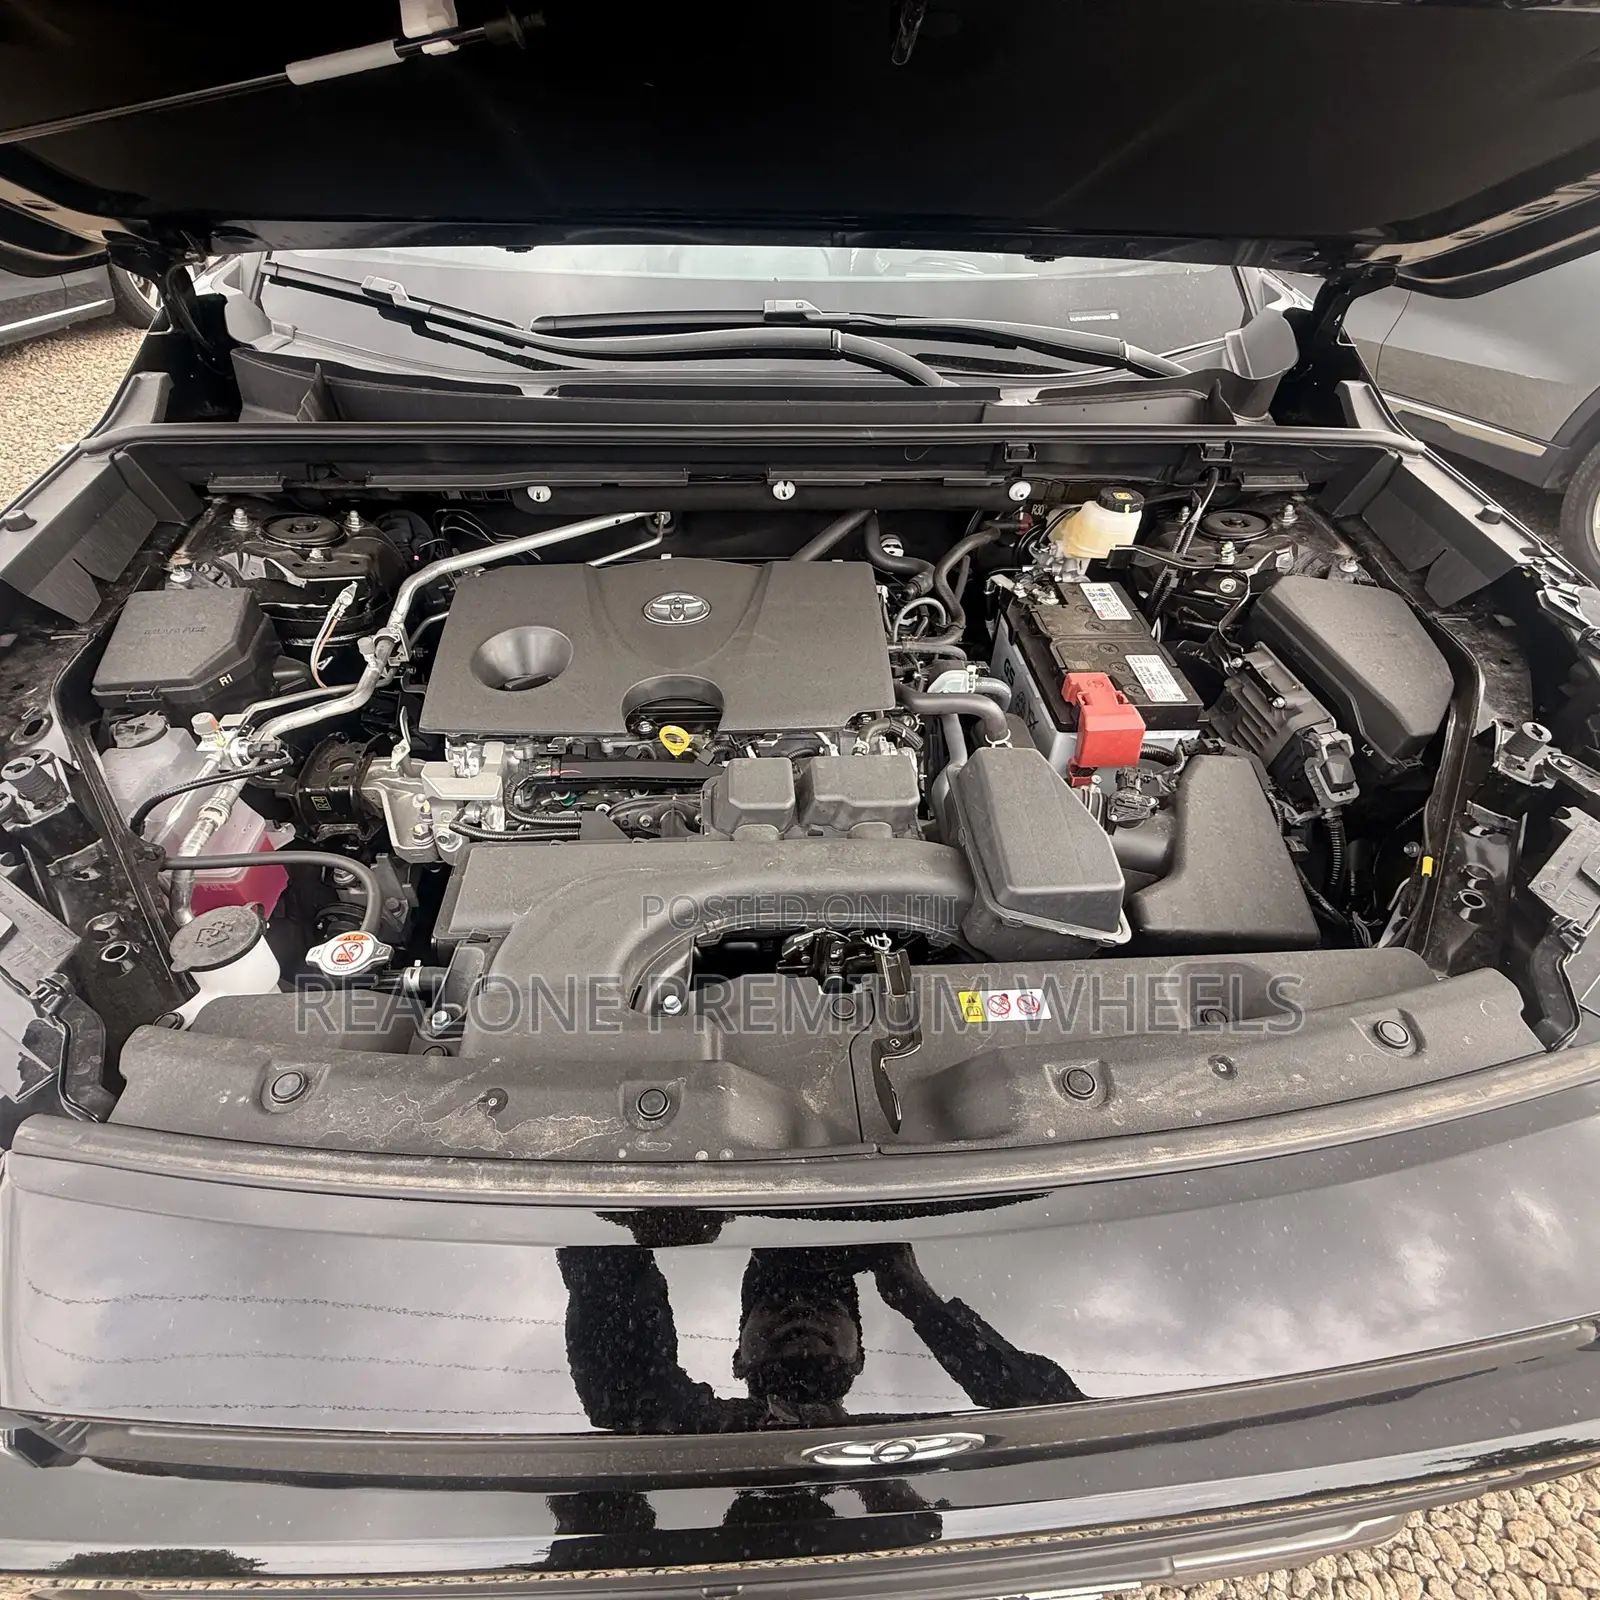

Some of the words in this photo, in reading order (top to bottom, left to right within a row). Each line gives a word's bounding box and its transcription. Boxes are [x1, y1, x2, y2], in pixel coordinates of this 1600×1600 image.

[1031, 504, 1045, 516] R30
[1003, 657, 1016, 687] GS
[219, 673, 233, 687] R1
[1360, 744, 1374, 757] L4
